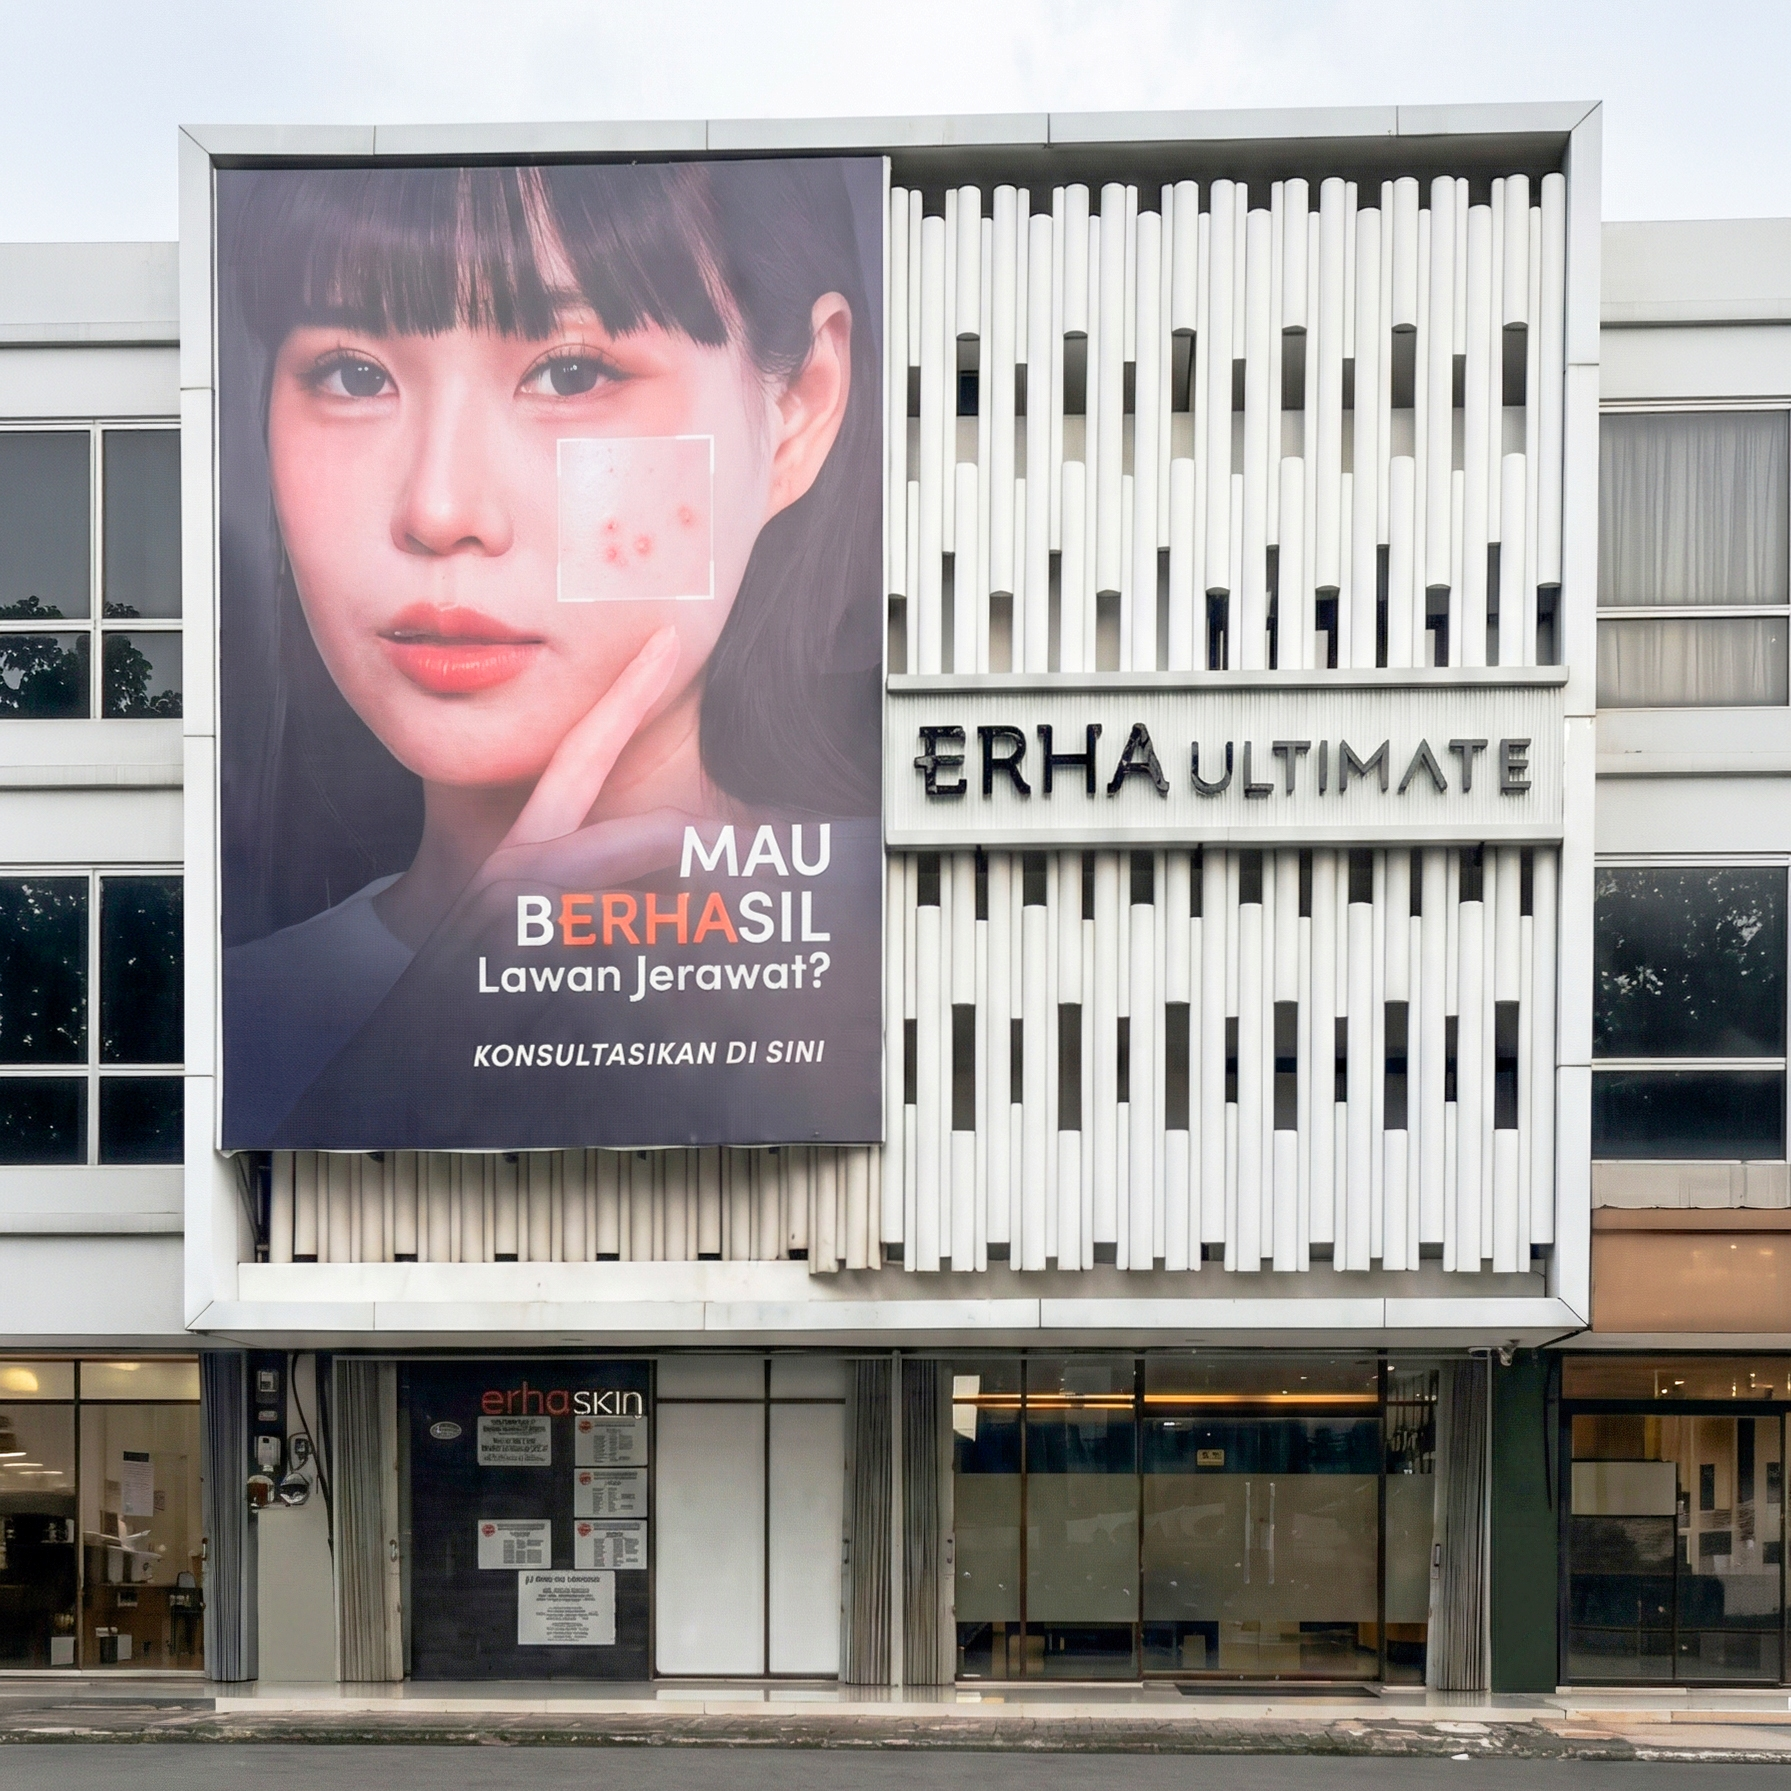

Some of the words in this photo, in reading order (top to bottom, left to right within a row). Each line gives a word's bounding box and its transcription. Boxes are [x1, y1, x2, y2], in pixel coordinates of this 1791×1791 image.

[914, 722, 1170, 797] ERHA
[1190, 737, 1533, 797] ULTIMATE
[679, 823, 831, 878] MAU
[517, 891, 831, 947] BERHASIL
[478, 956, 621, 993] Lawan
[629, 951, 831, 1002] Jerawat?
[474, 1041, 717, 1067] KONSULTASIKAN
[726, 1041, 757, 1065] DI
[765, 1040, 825, 1064] SINI
